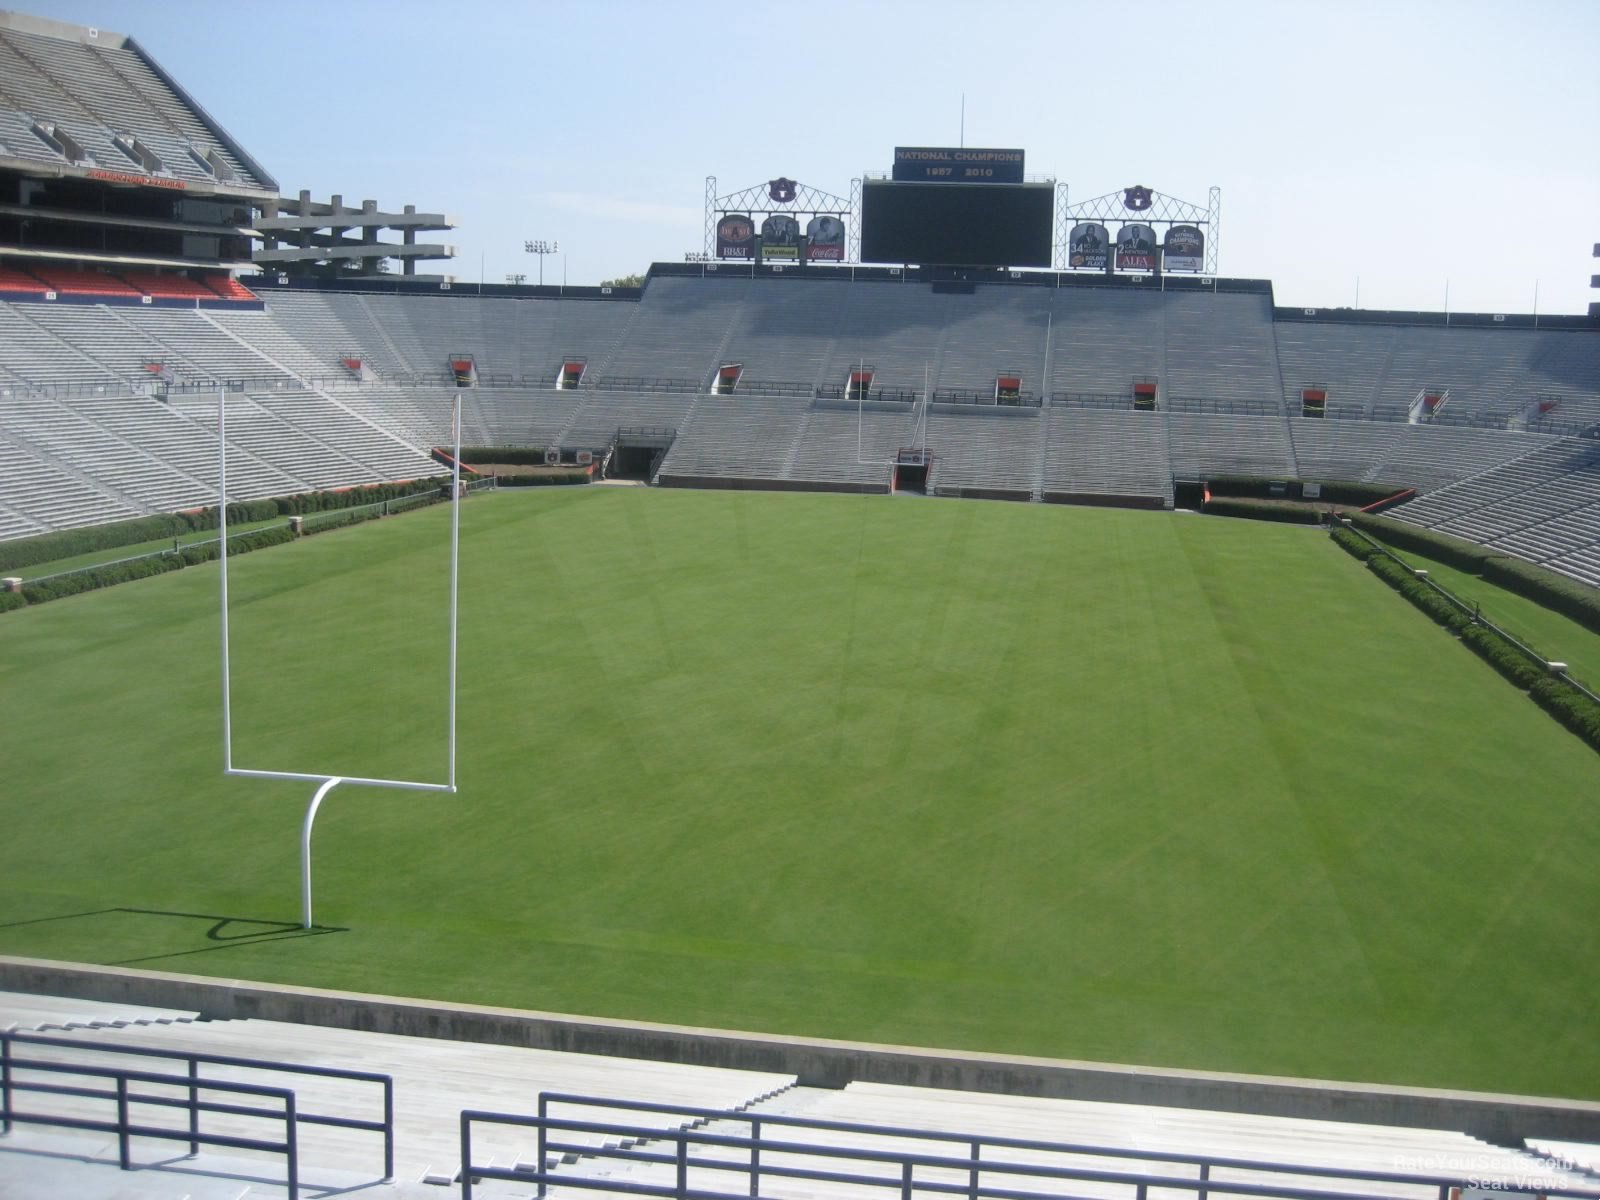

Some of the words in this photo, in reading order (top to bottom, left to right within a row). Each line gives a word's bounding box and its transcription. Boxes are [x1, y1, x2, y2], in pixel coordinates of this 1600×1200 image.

[896, 151, 951, 161] NATIONAL
[954, 152, 1022, 161] CHAMPIONS
[965, 168, 993, 177] 2010
[723, 247, 748, 257] BB&T
[1122, 256, 1149, 265] ALFA
